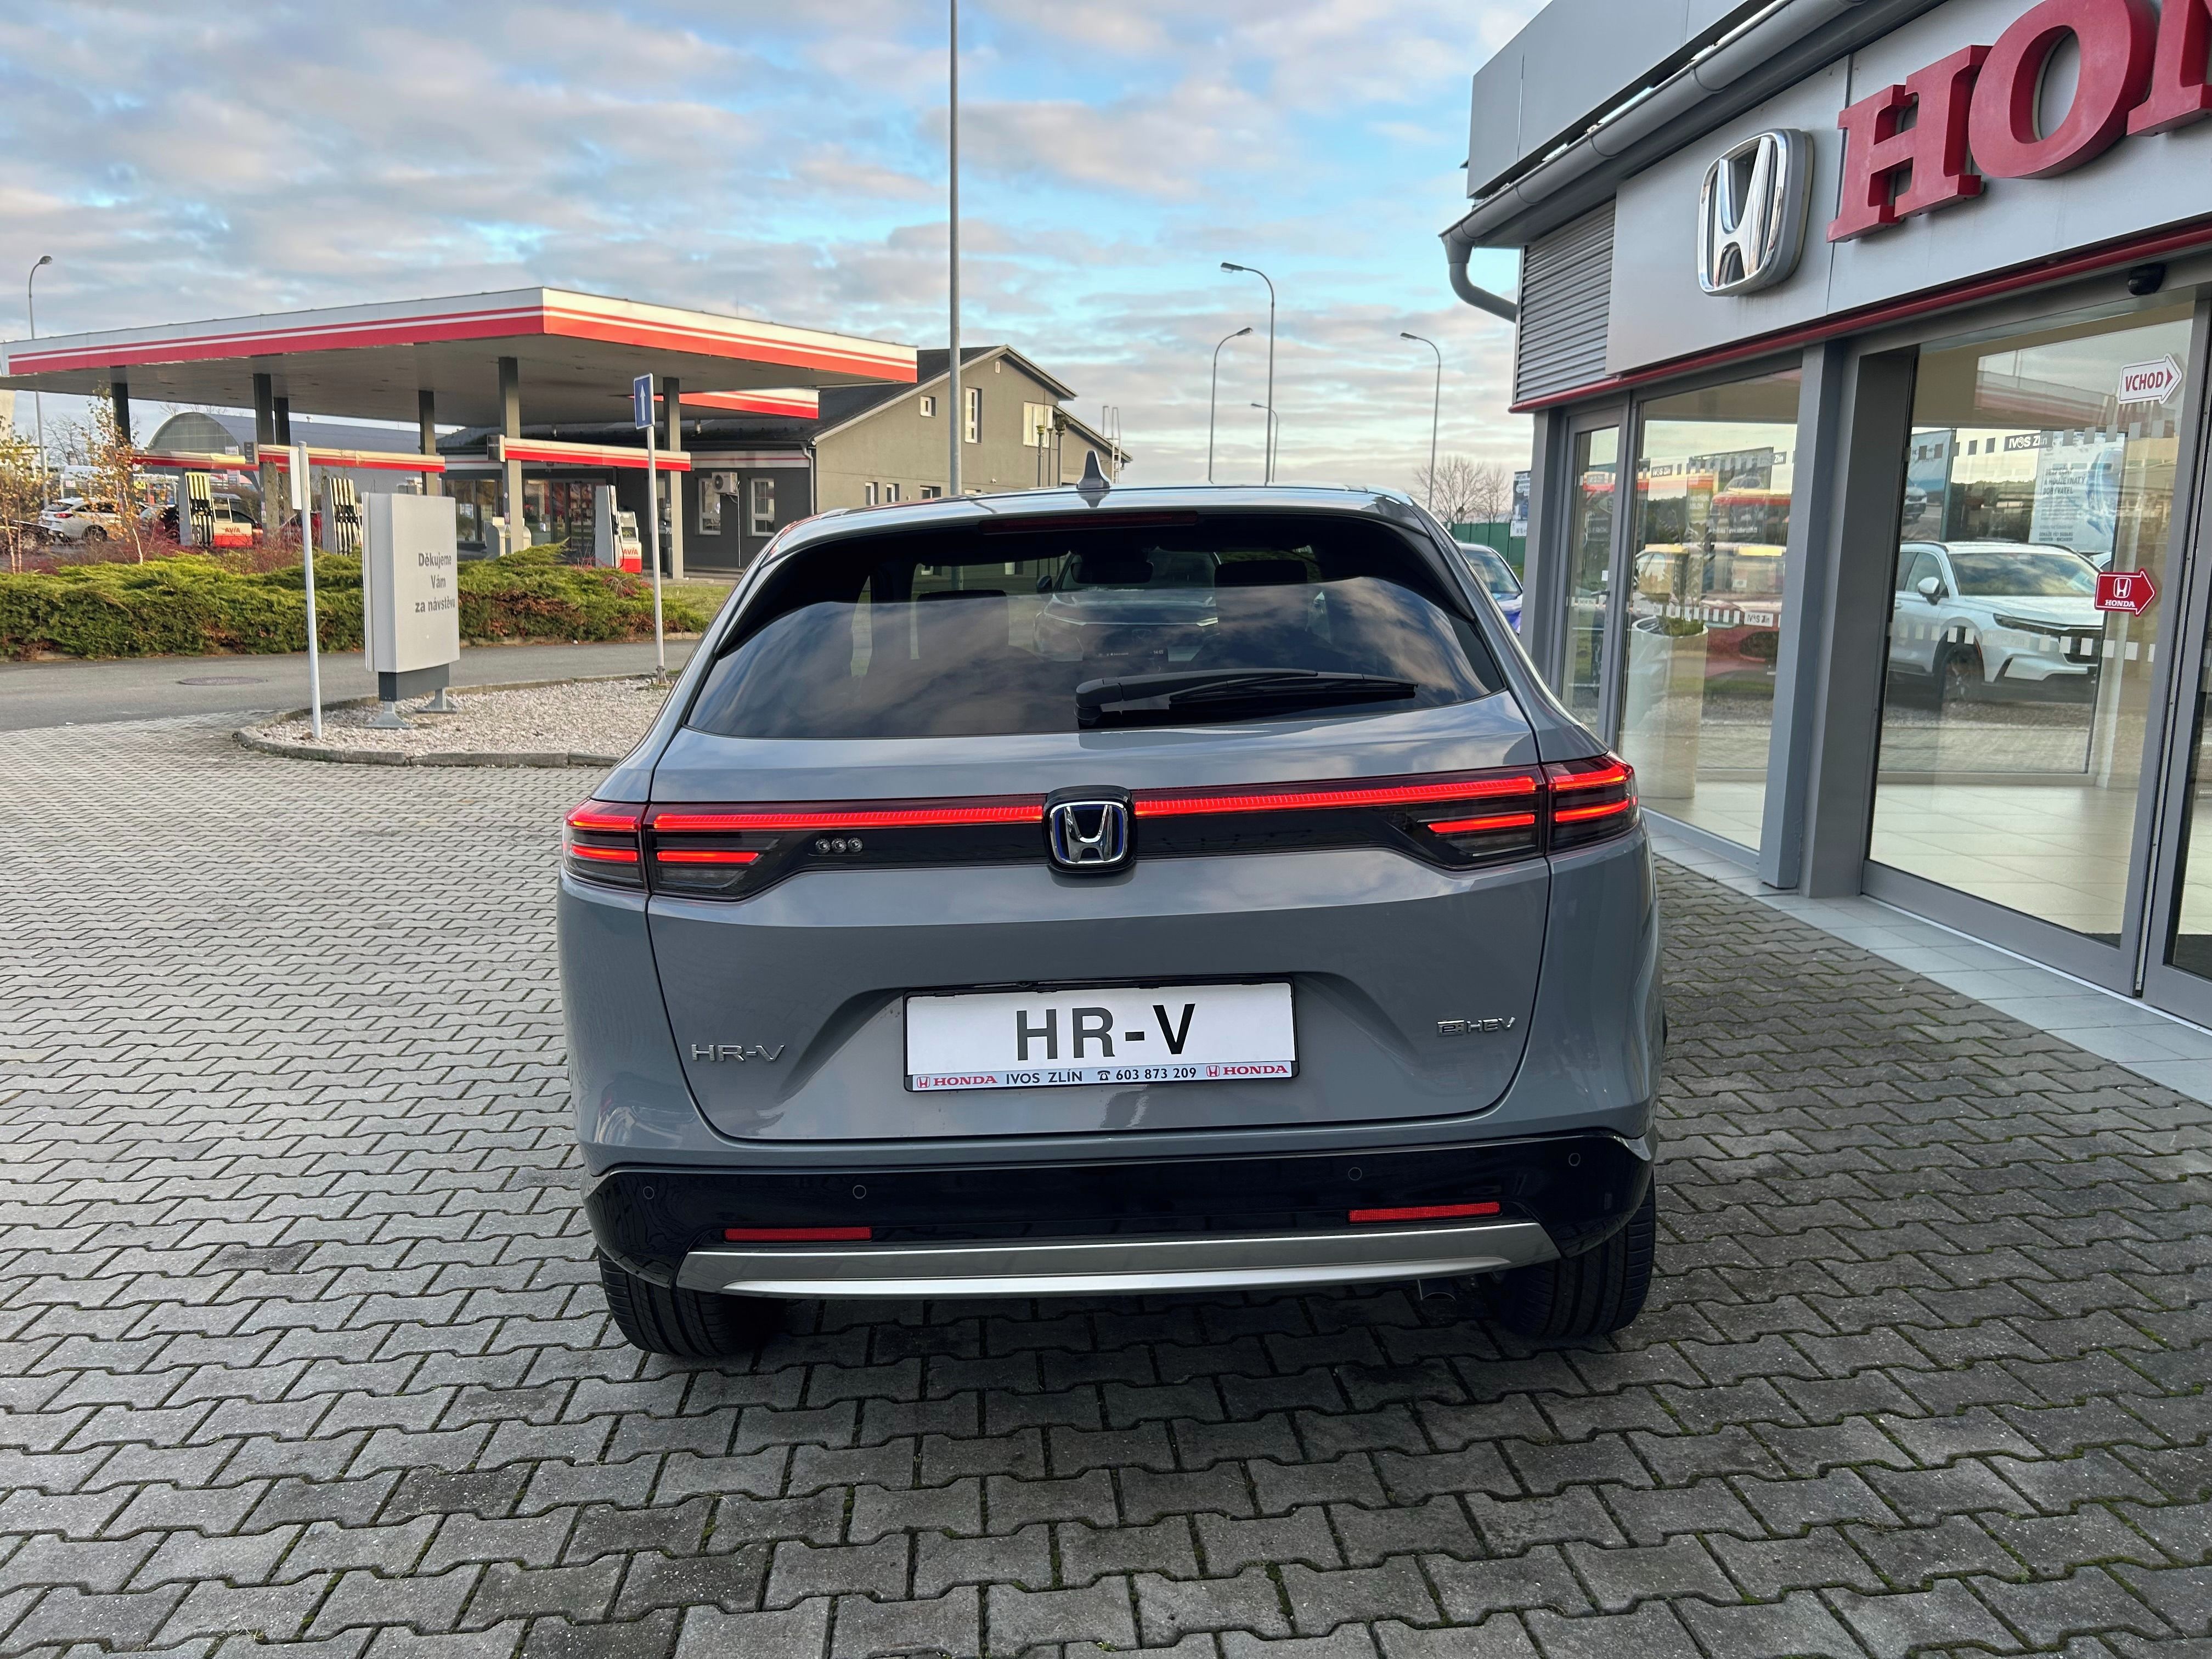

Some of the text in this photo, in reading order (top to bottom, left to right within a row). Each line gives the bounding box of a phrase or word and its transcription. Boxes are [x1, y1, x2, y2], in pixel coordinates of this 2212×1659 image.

[2125, 371, 2164, 392] VCHOD
[418, 552, 452, 569] Děkujeme
[431, 574, 446, 589] Vám
[415, 601, 426, 613] za
[1016, 1003, 1196, 1061] HR-V
[691, 1044, 785, 1062] HR-V
[933, 1075, 998, 1086] HONDA
[1006, 1073, 1040, 1085] IVOS
[1048, 1069, 1082, 1083] ZLÍN
[1116, 1069, 1139, 1081] 603
[1144, 1068, 1167, 1079] 873
[1173, 1067, 1197, 1079] 209
[1223, 1065, 1288, 1075] HONDA
